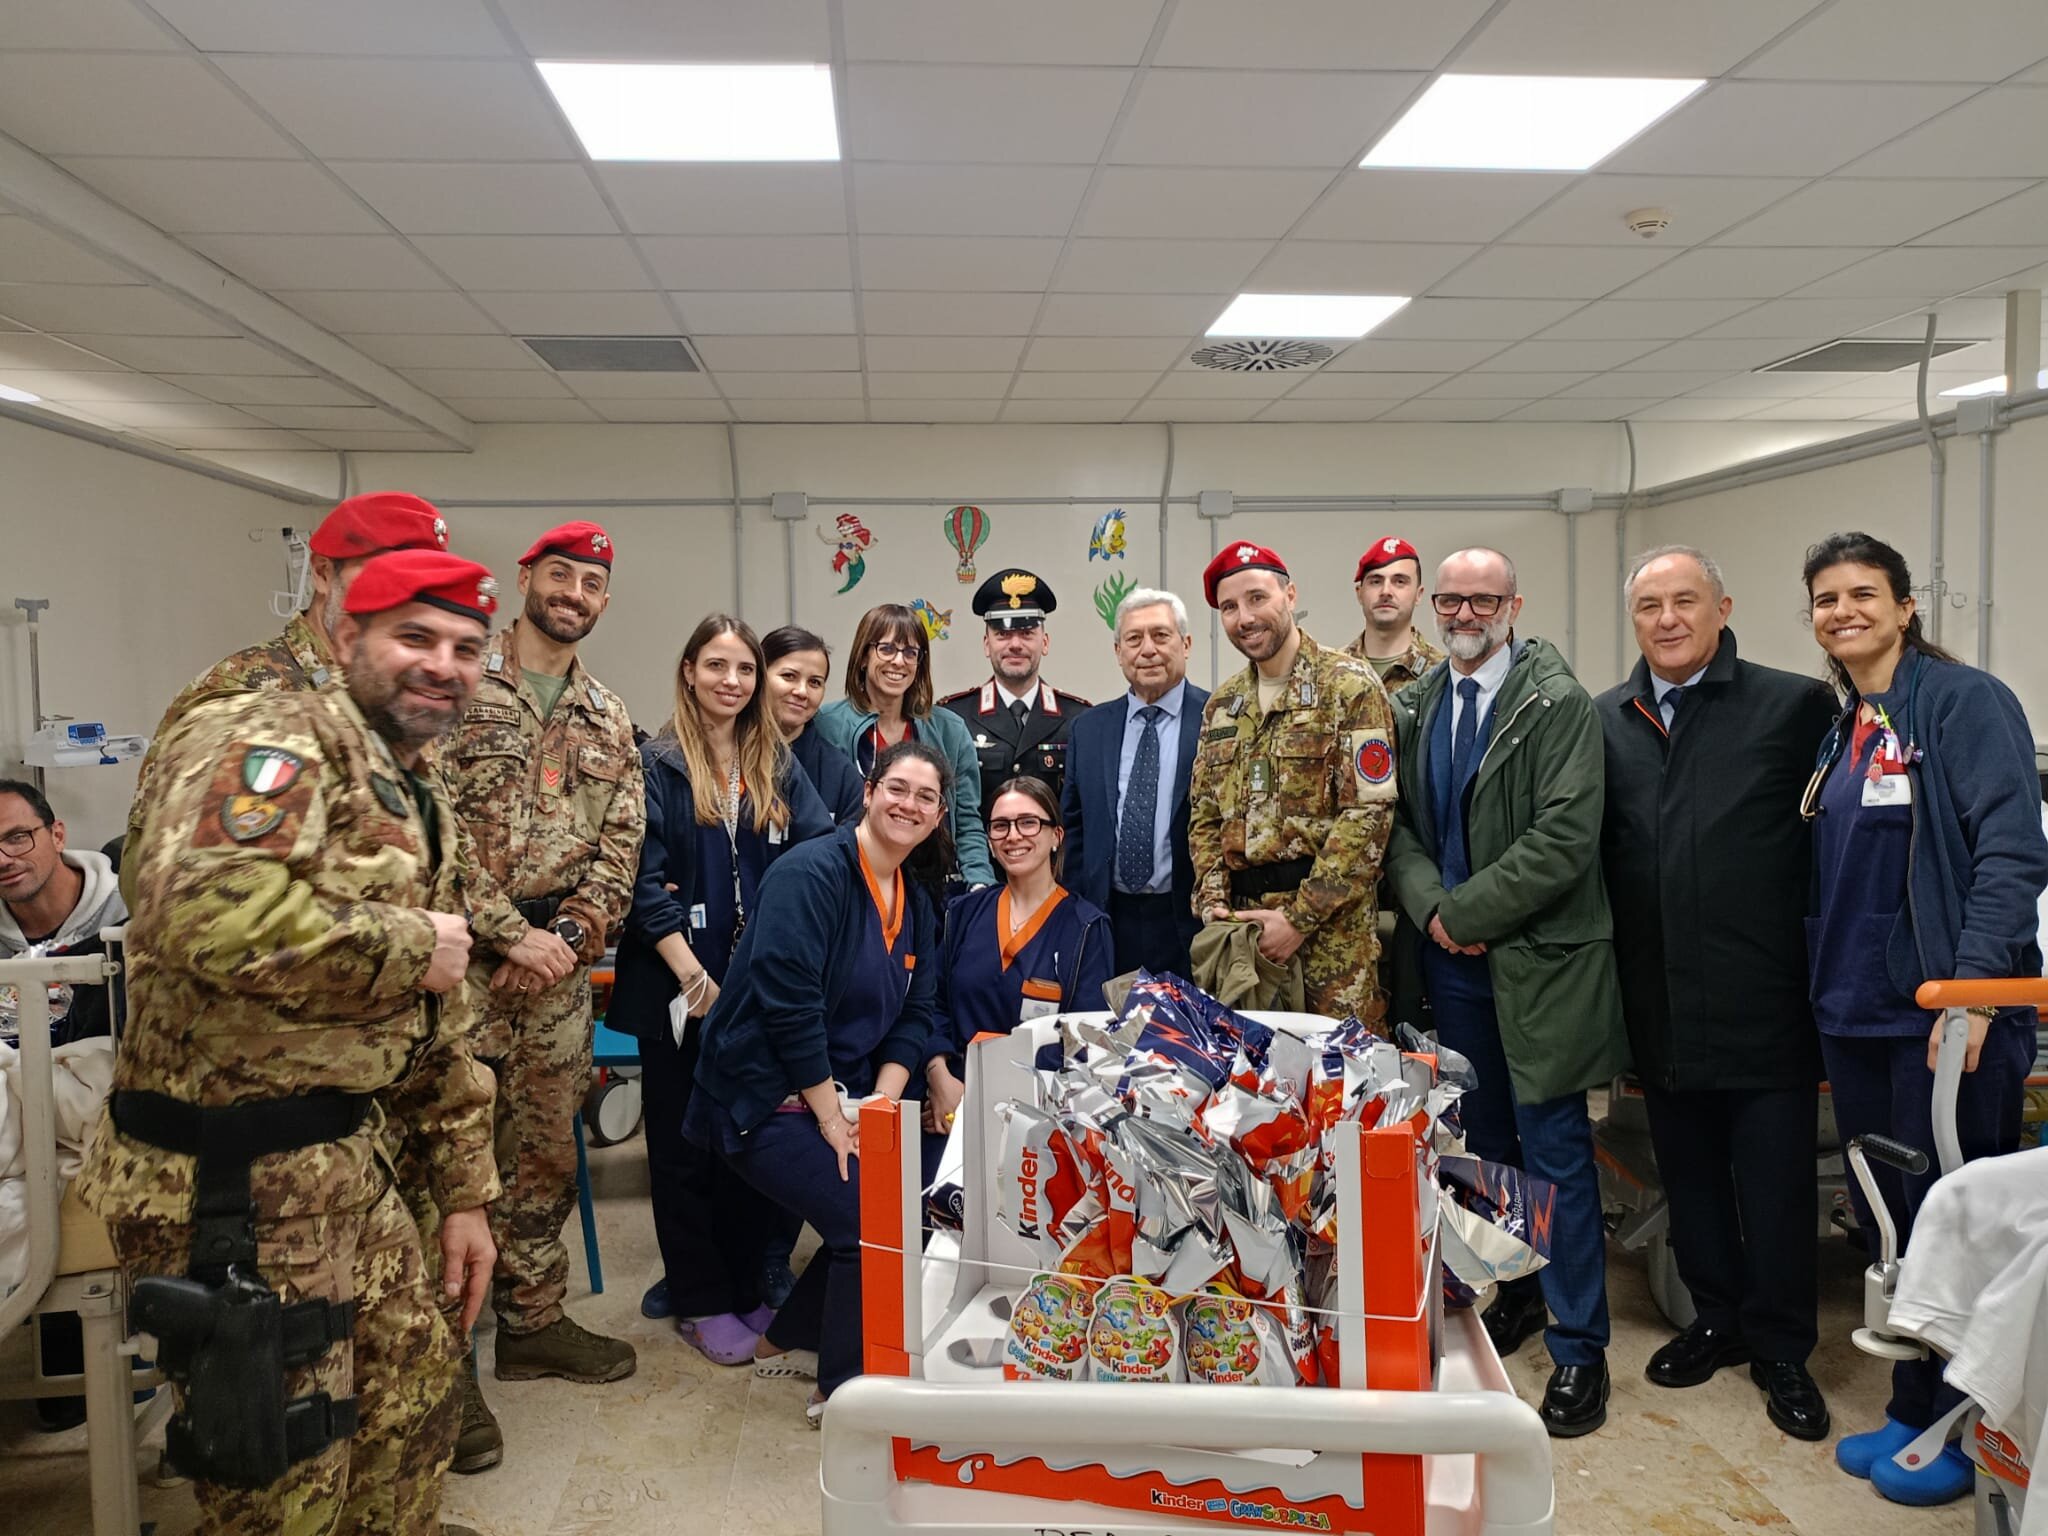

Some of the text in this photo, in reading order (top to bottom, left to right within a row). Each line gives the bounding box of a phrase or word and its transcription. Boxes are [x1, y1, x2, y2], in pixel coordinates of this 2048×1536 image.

[1018, 1146, 1041, 1241] Kinder
[1024, 1339, 1062, 1365] Kinder
[1112, 1360, 1152, 1375] Kinder
[1206, 1370, 1244, 1384] Kinder
[1152, 1490, 1203, 1510] Kinder
